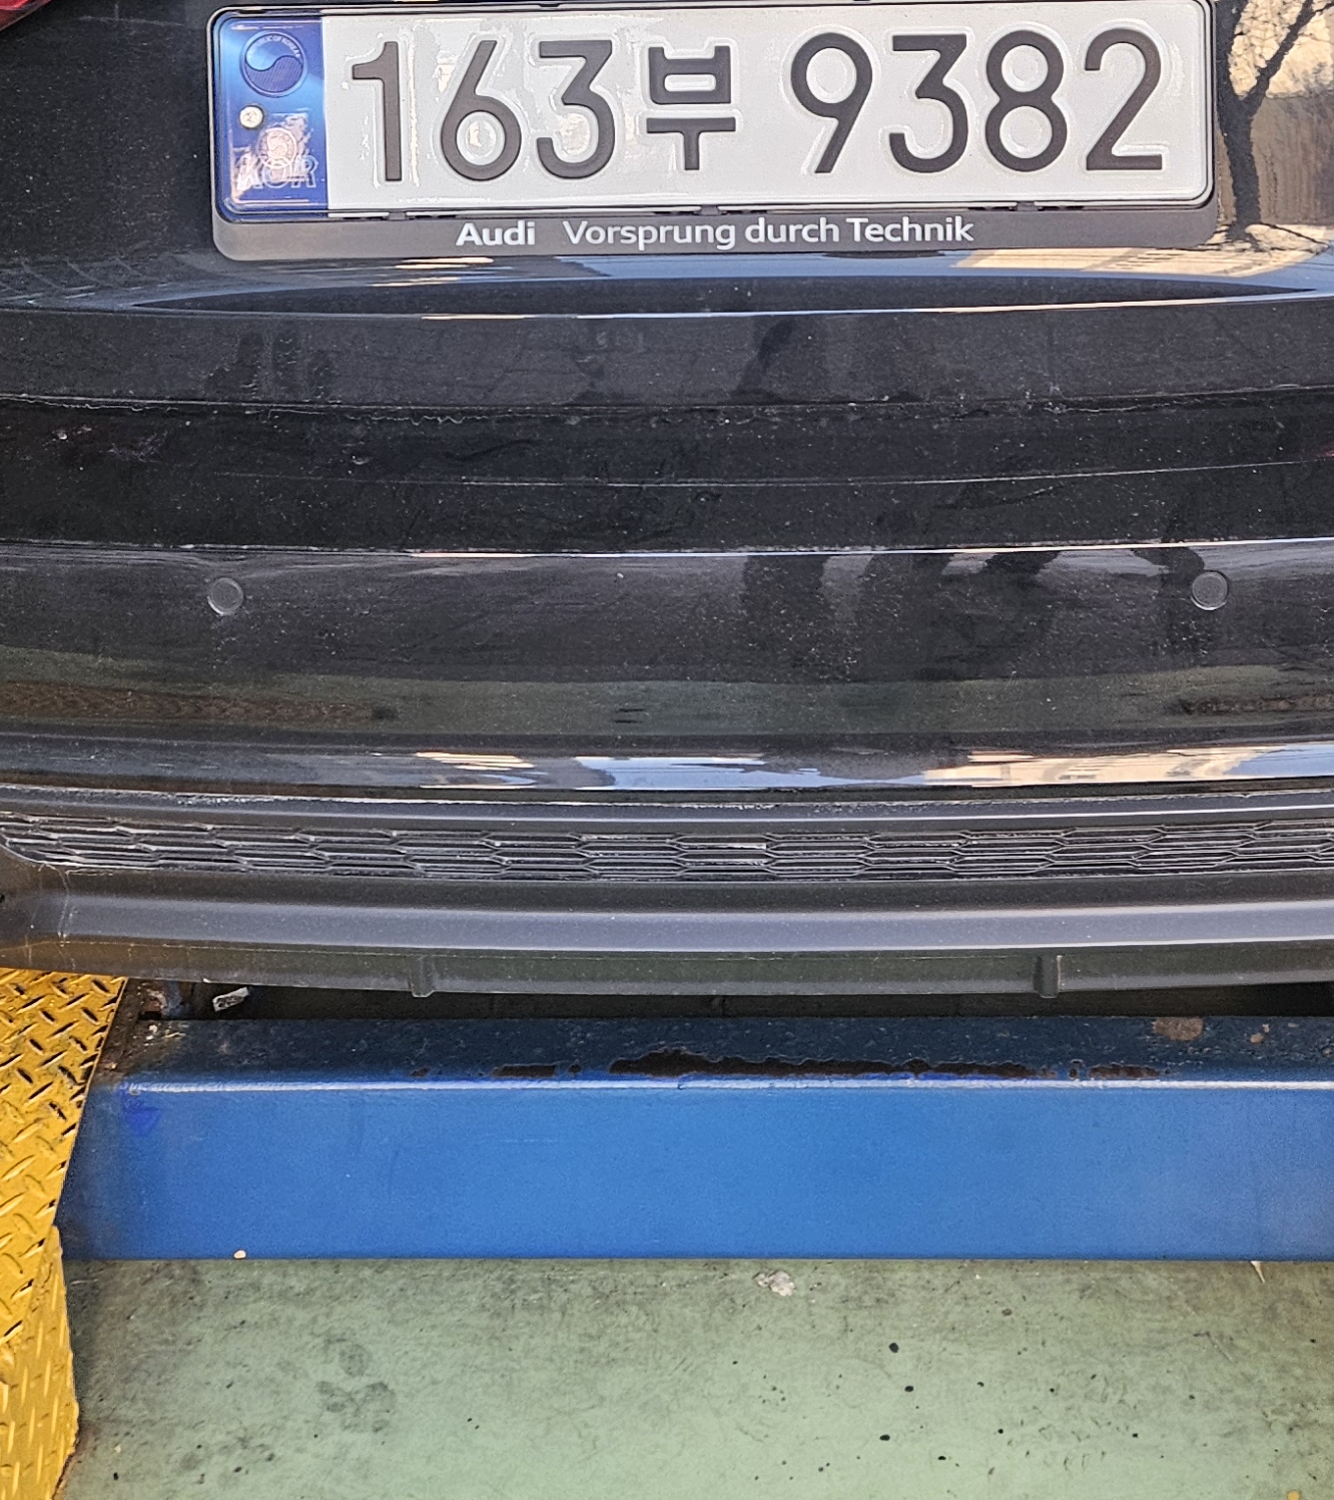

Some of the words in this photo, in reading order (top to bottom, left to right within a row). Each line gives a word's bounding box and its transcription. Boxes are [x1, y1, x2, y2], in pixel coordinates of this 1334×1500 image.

[351, 38, 737, 182] 163부
[789, 28, 1165, 175] 9382
[456, 221, 535, 246] Audi
[563, 220, 736, 250] Vorsprung
[744, 217, 839, 244] durch
[846, 216, 974, 243] Technik
